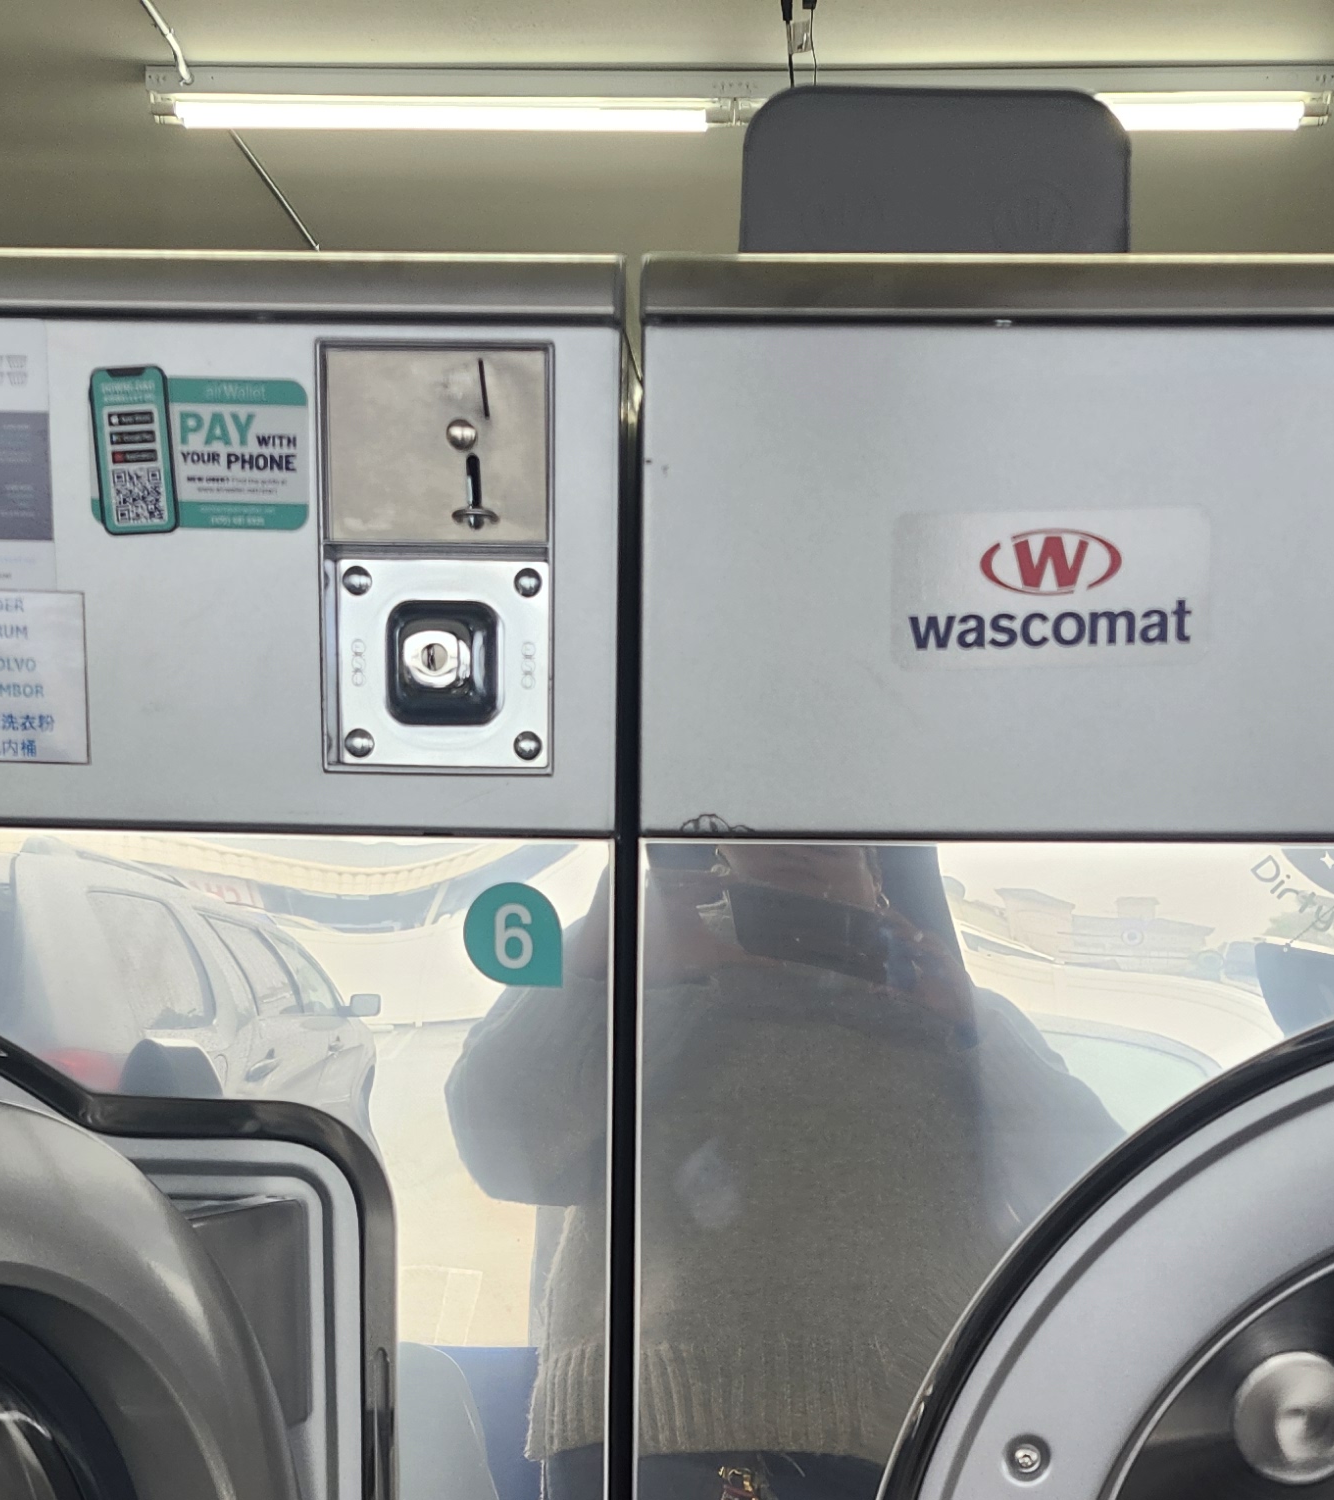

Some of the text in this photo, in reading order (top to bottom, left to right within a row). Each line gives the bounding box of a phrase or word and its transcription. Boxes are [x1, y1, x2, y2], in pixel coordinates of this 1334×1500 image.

[178, 411, 256, 446] PAY
[256, 434, 297, 449] WITH
[181, 452, 297, 472] YOUR PHONE
[908, 598, 1193, 651] wascomat
[493, 902, 533, 970] 6
